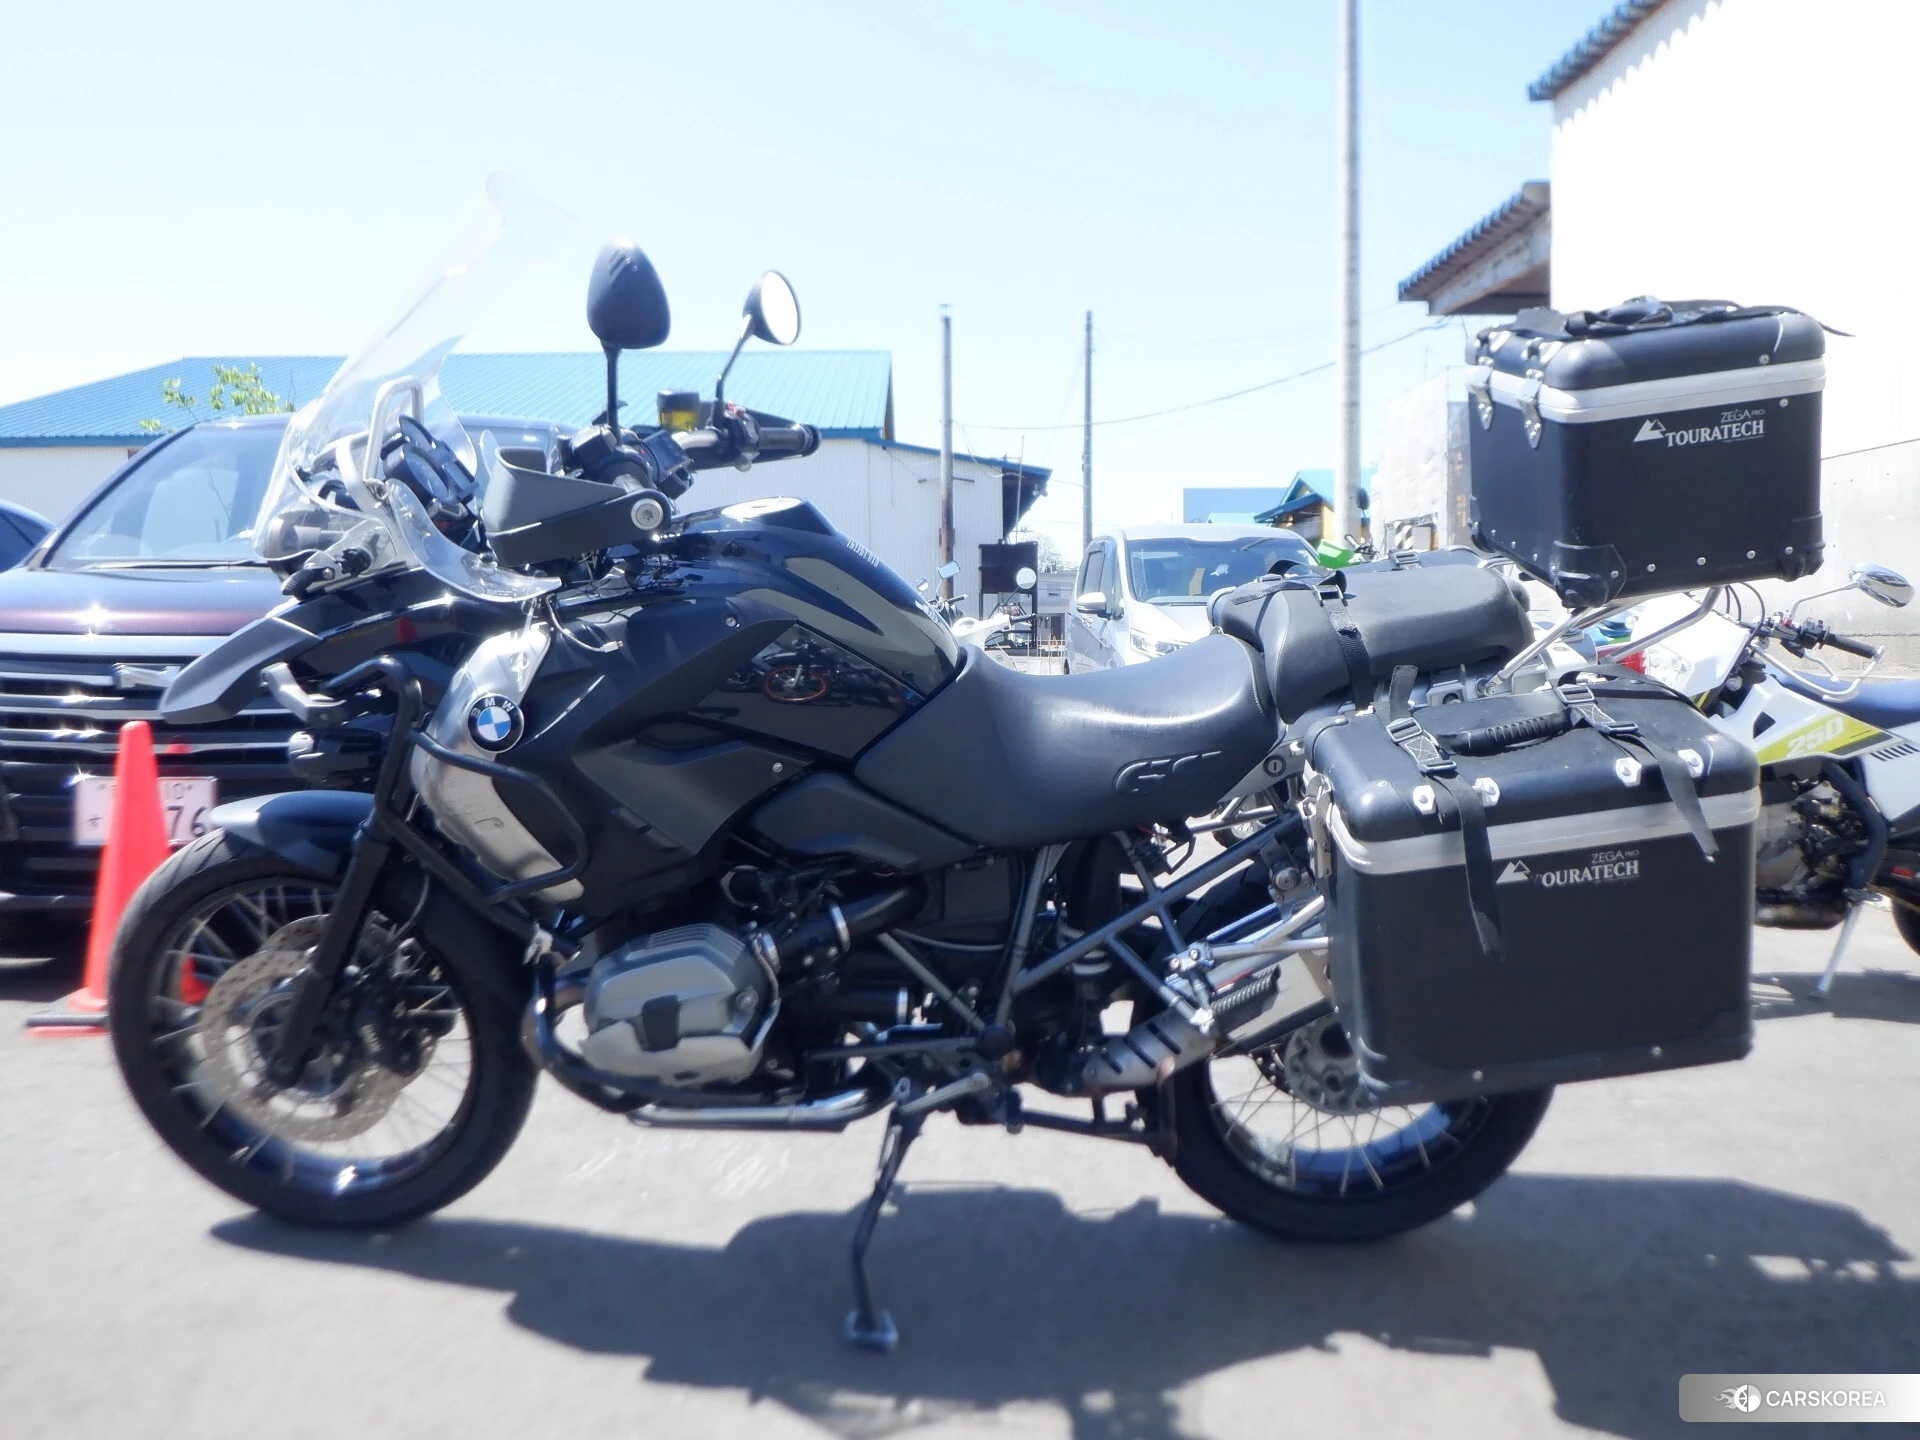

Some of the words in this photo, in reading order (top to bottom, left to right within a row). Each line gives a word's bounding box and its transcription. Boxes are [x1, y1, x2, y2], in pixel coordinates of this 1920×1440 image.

[1720, 409, 1751, 423] ZEGA
[1664, 419, 1765, 447] TOURATECH
[470, 697, 515, 718] BMW
[1787, 715, 1845, 758] 250
[1592, 850, 1625, 864] ZEGA
[1533, 859, 1640, 888] OURATECH
